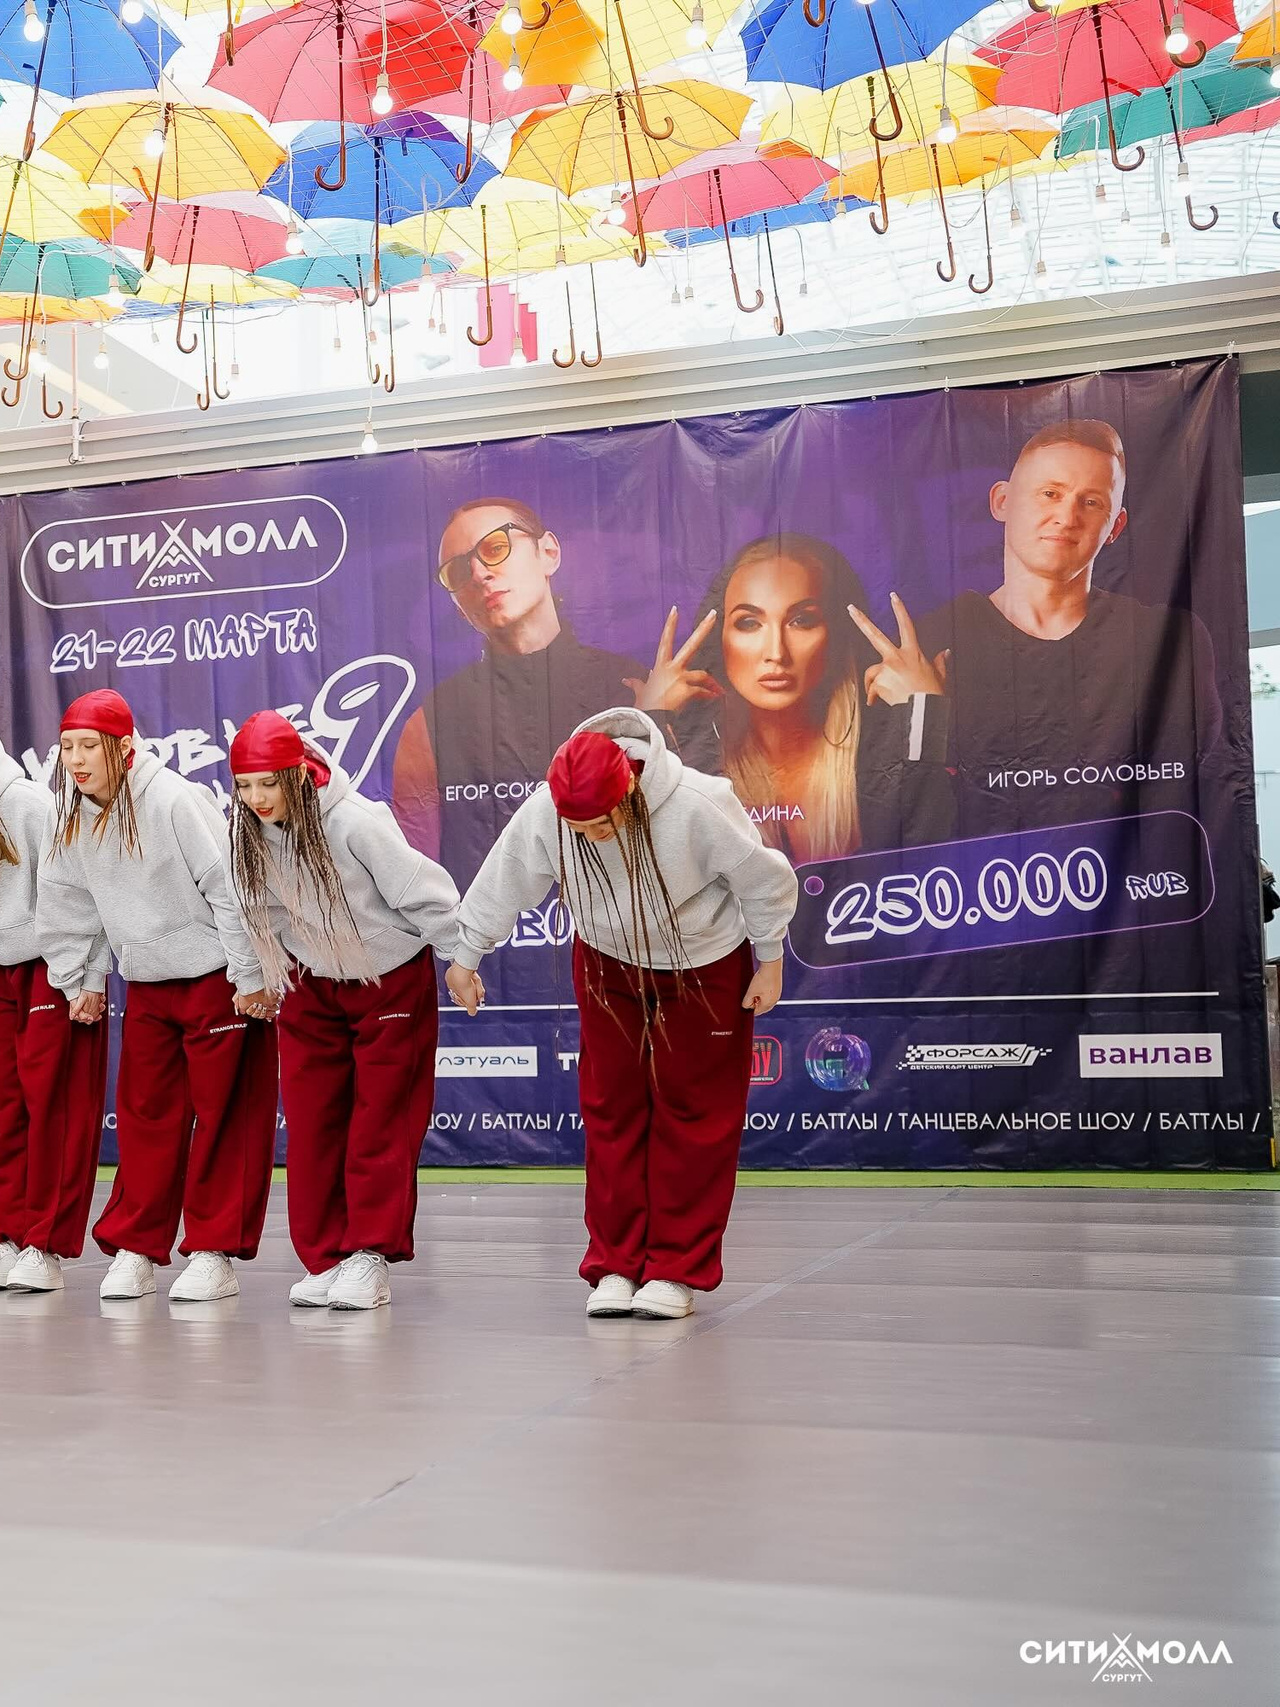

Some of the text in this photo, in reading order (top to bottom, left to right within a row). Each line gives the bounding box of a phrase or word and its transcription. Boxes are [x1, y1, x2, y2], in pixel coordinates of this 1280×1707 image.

[47, 516, 319, 573] СИТИ МОЛЛ
[149, 571, 201, 588] СУРГУТ
[50, 607, 318, 674] 21-22 МАРТА
[988, 762, 1186, 789] ИГОРЬ СОЛОВЬЕВ
[445, 783, 490, 801] ЕГОР
[824, 846, 1190, 945] 250.000 RUB
[926, 1047, 1020, 1059] ФОРСАЖ
[1089, 1046, 1213, 1065] ванлав
[481, 1112, 551, 1131] БАТТЛЫ
[801, 1112, 878, 1131] БАТТЛЫ
[898, 1111, 1072, 1132] ТАНЦЕВАЛЬНОЕ
[1078, 1111, 1135, 1131] ШОУ
[1159, 1112, 1244, 1131] БАТТЛЫ
